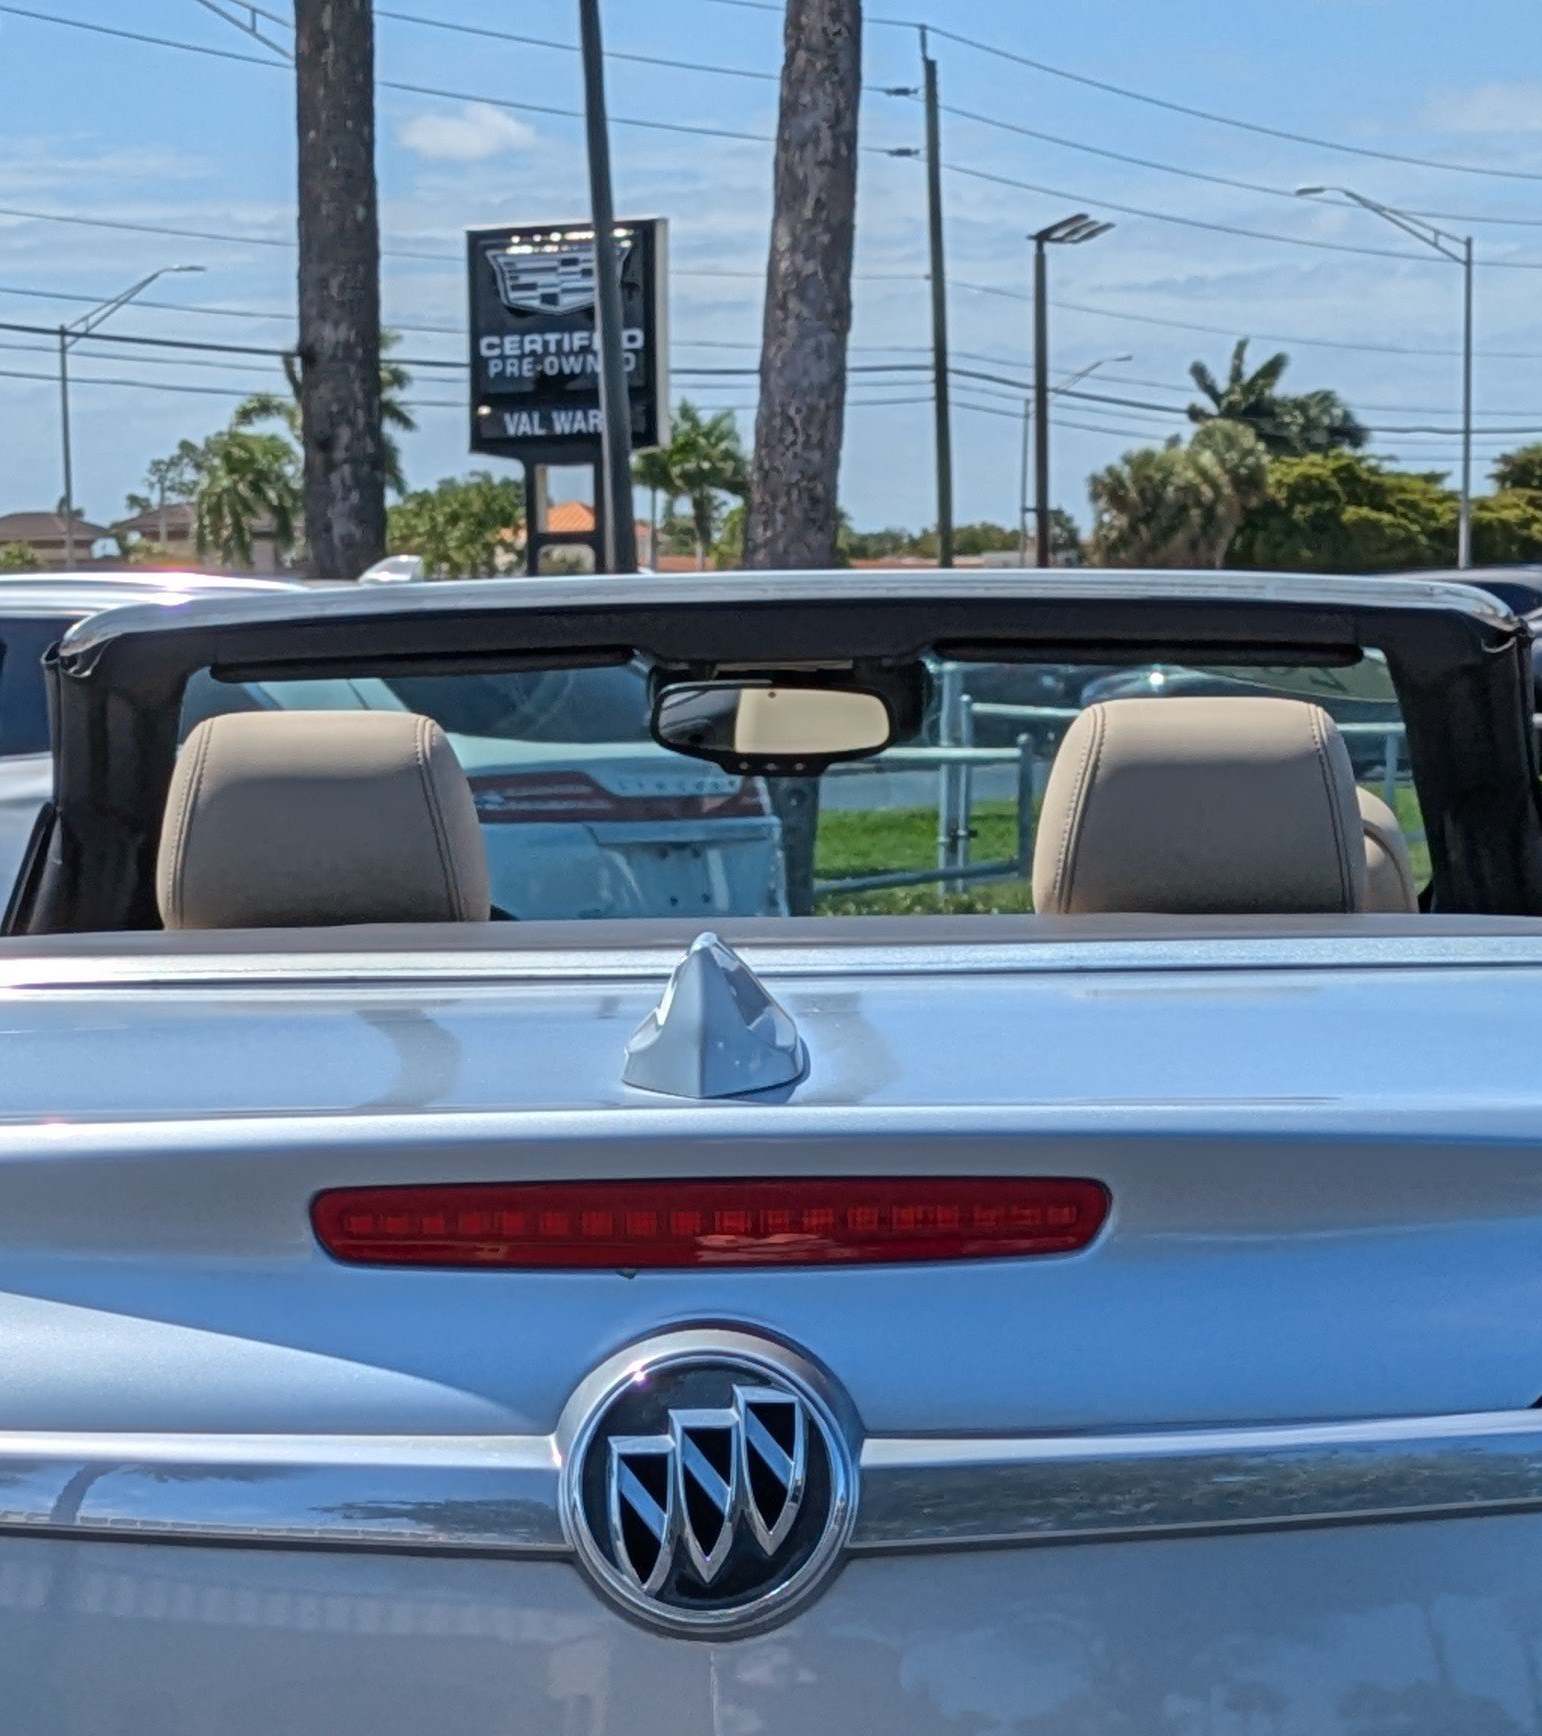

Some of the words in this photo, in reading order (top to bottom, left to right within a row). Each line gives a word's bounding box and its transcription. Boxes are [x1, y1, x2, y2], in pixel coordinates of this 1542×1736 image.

[479, 327, 645, 357] CERTIFID
[488, 351, 637, 378] PRE-OWND
[504, 411, 547, 438] VAL
[550, 408, 604, 434] WAR
